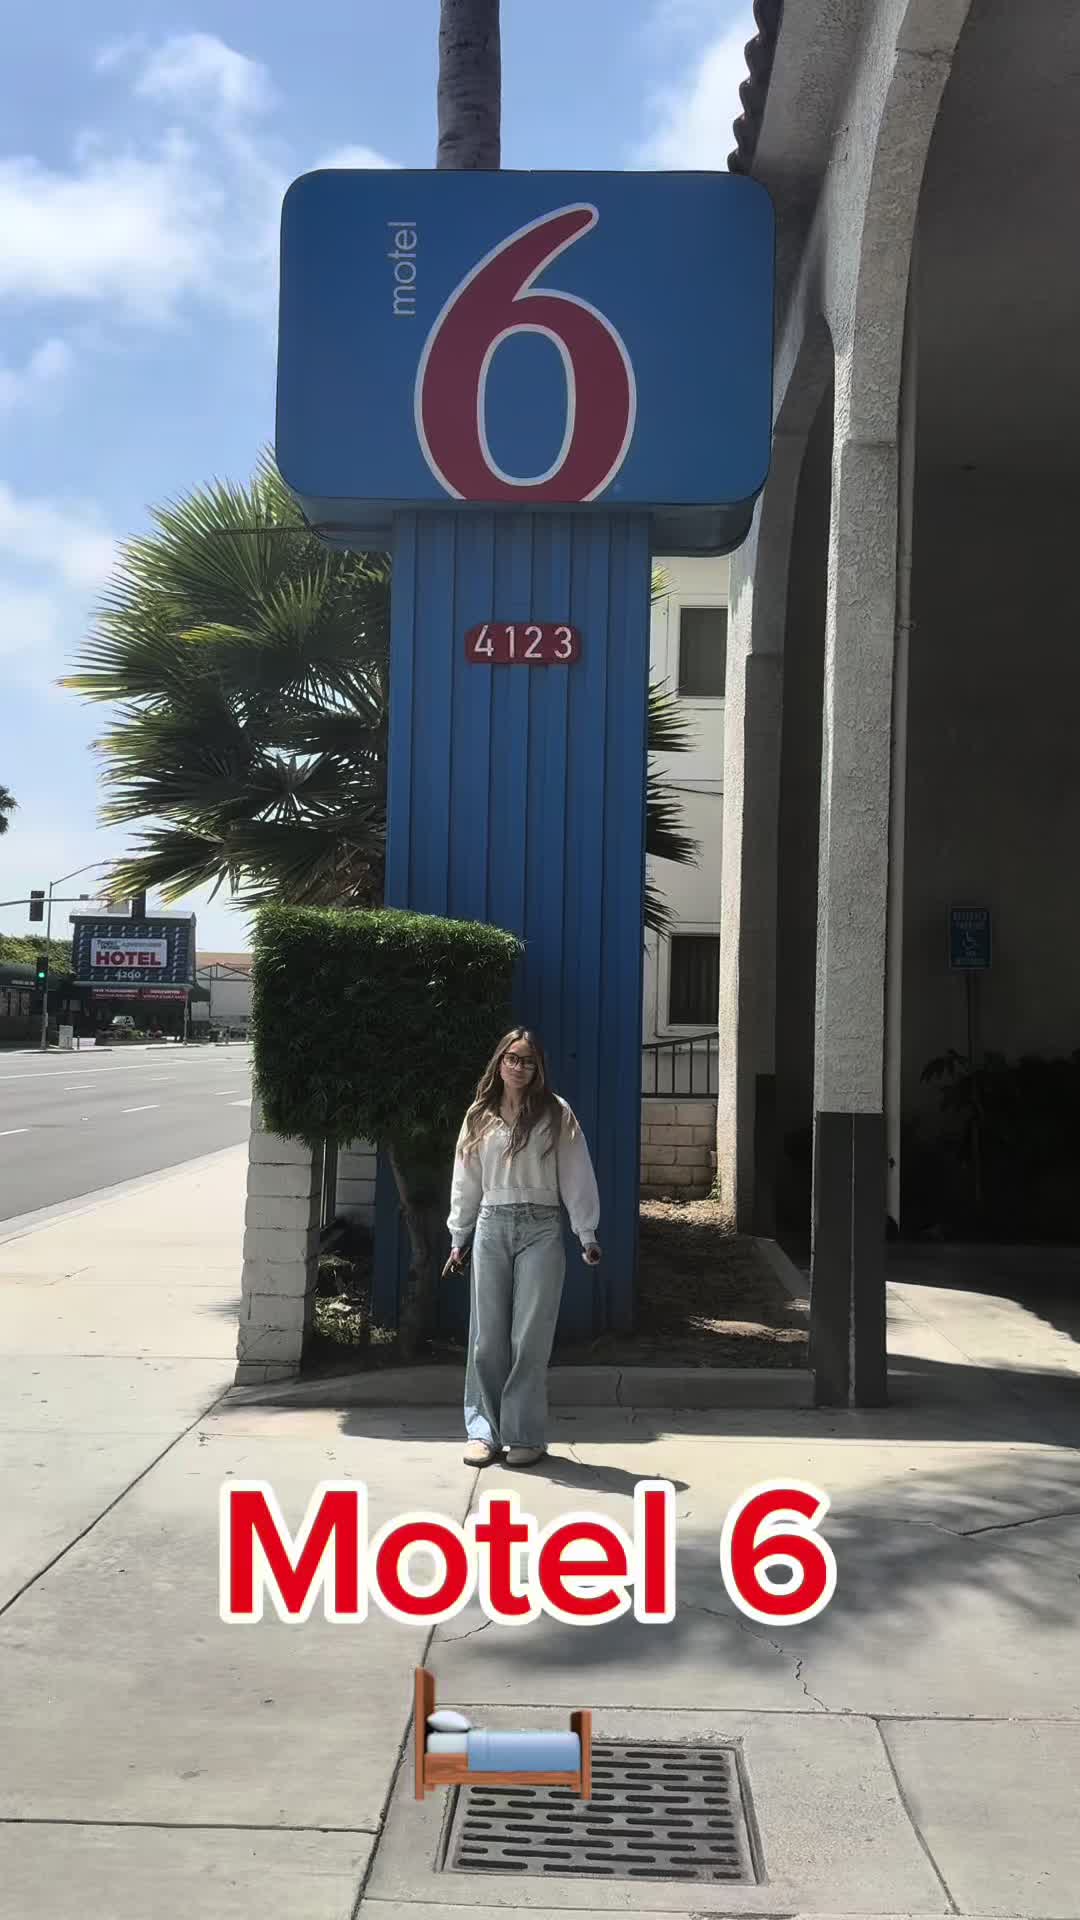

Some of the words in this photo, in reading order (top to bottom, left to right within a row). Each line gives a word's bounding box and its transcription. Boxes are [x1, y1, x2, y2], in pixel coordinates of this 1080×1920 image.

[385, 220, 418, 318] motel
[413, 202, 638, 503] 6
[473, 624, 573, 659] 4123
[95, 951, 162, 966] HOTEL
